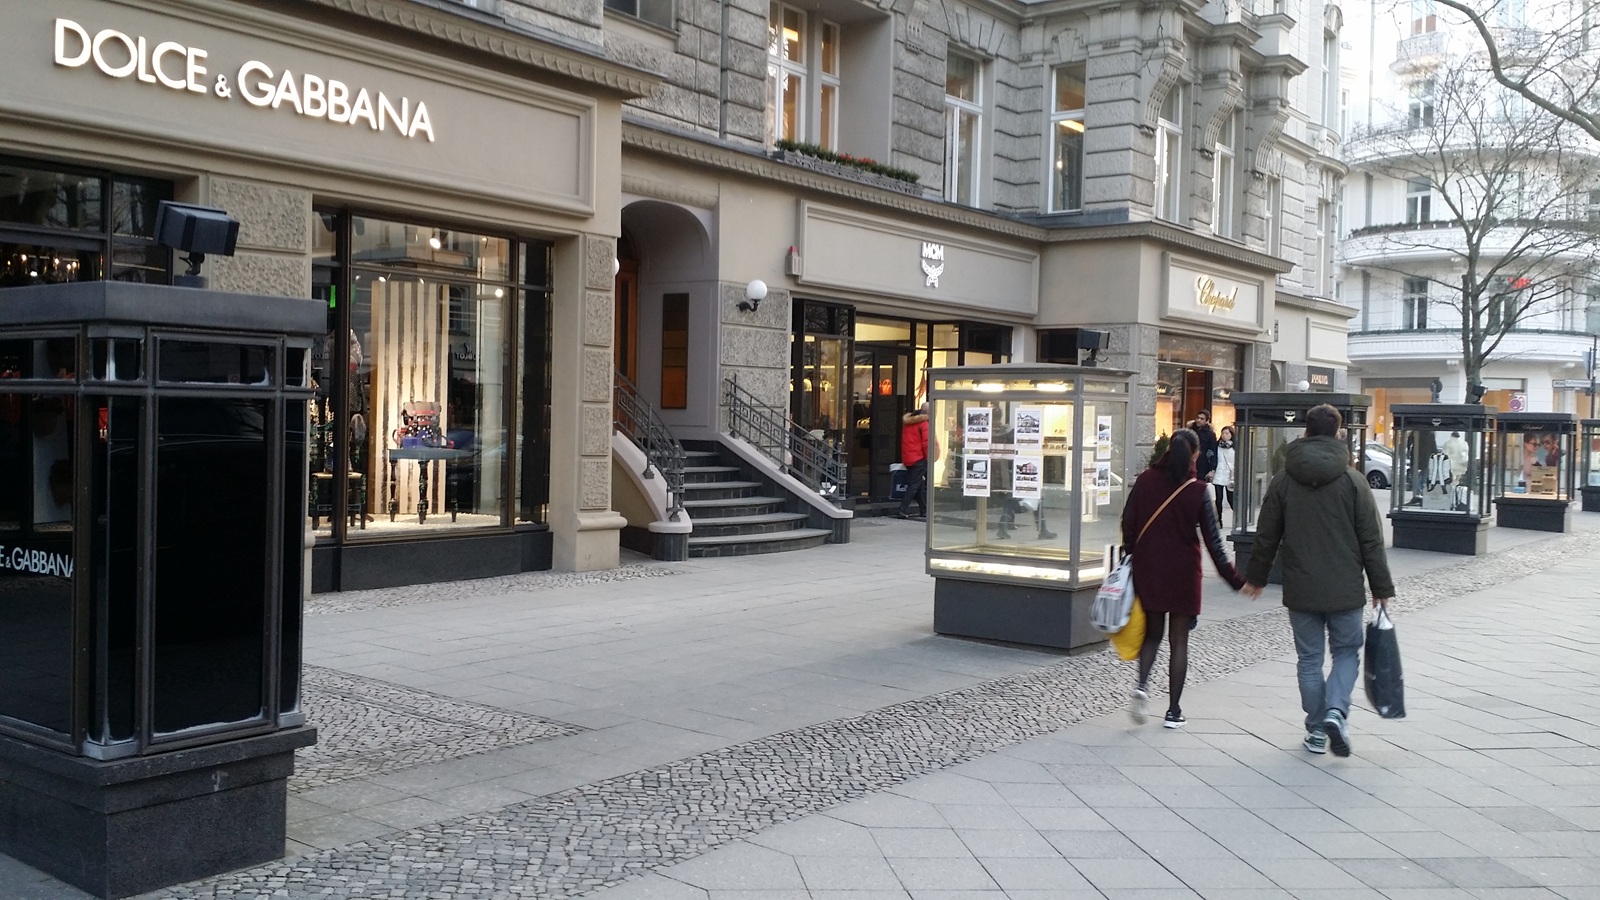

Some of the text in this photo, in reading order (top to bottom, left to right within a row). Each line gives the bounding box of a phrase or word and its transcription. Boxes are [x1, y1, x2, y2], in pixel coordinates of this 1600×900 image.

[54, 18, 435, 142] DOLCE & GABBANA
[922, 242, 945, 261] MCM
